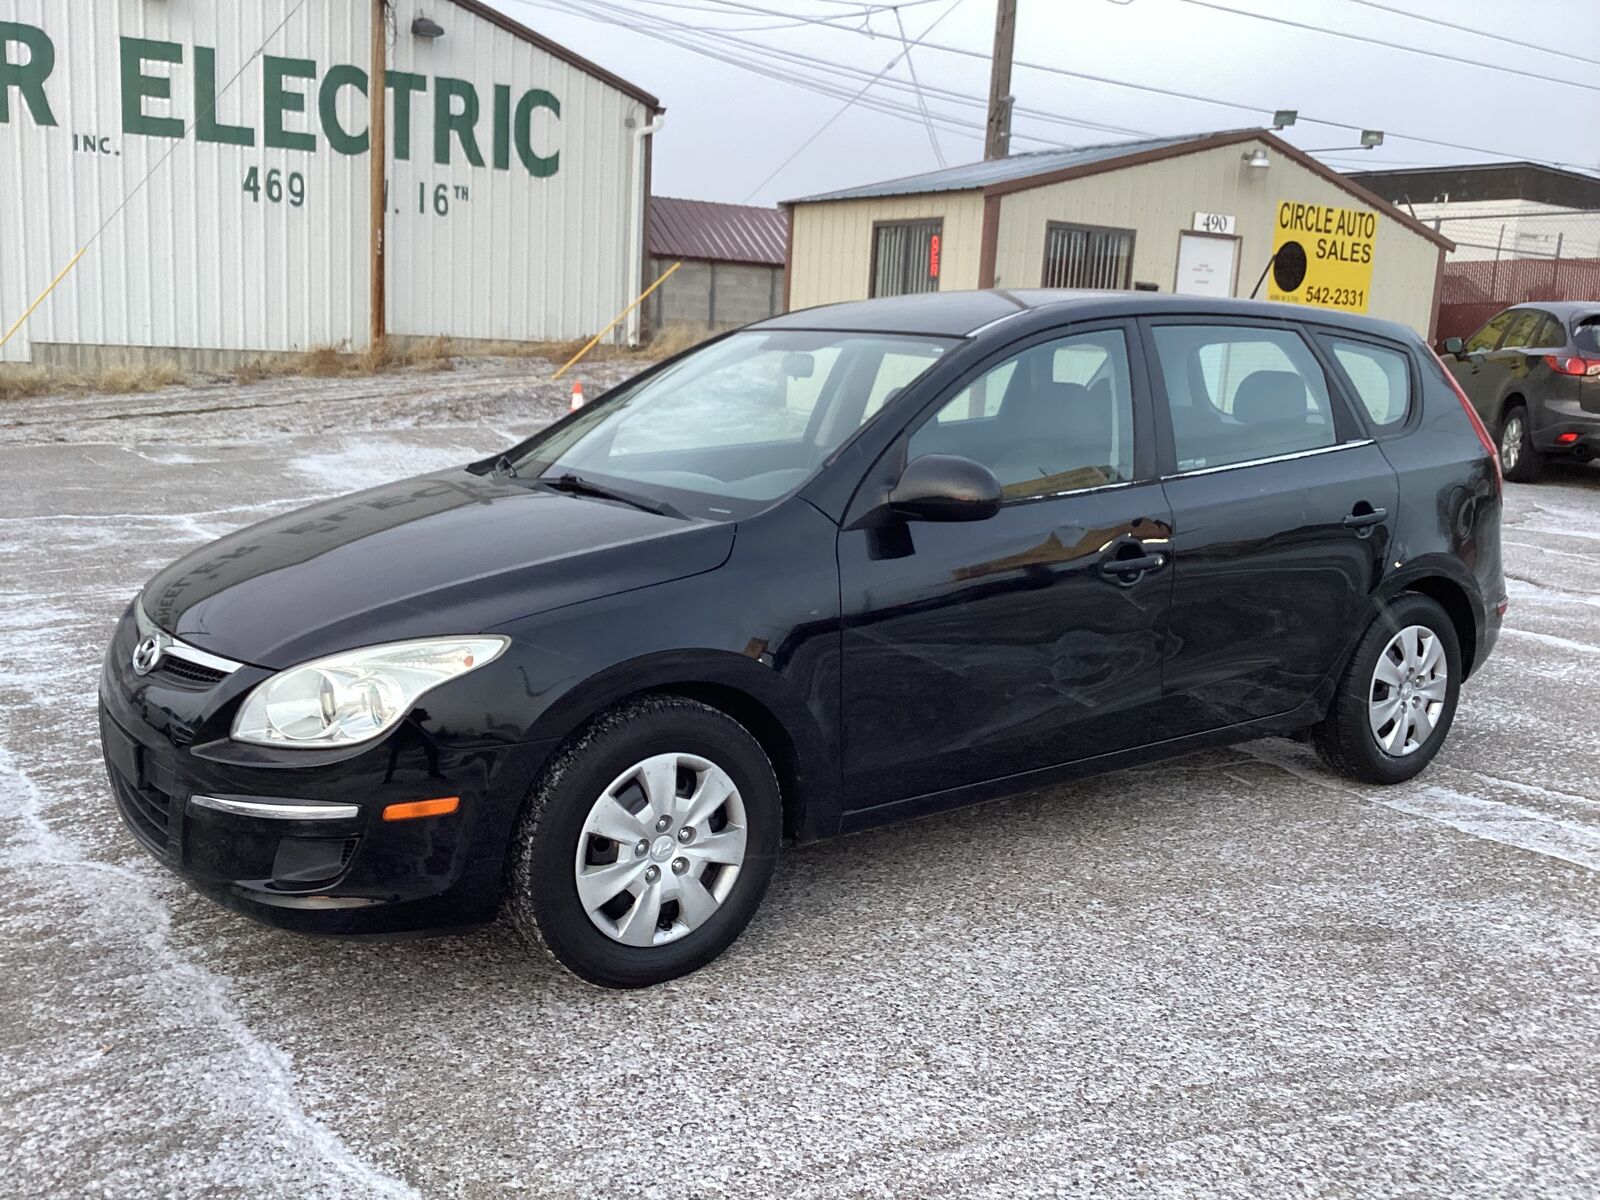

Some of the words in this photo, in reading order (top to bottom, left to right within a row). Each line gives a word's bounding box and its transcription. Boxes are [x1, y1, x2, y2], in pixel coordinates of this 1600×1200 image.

[119, 36, 561, 179] ELECTRIC
[73, 133, 120, 156] INC.
[243, 166, 306, 207] 469
[1201, 213, 1228, 233] 490
[1279, 202, 1334, 234] CIRCLE
[1335, 209, 1376, 239] AUTO
[1315, 239, 1372, 264] SALES
[1305, 286, 1364, 307] 542-2331
